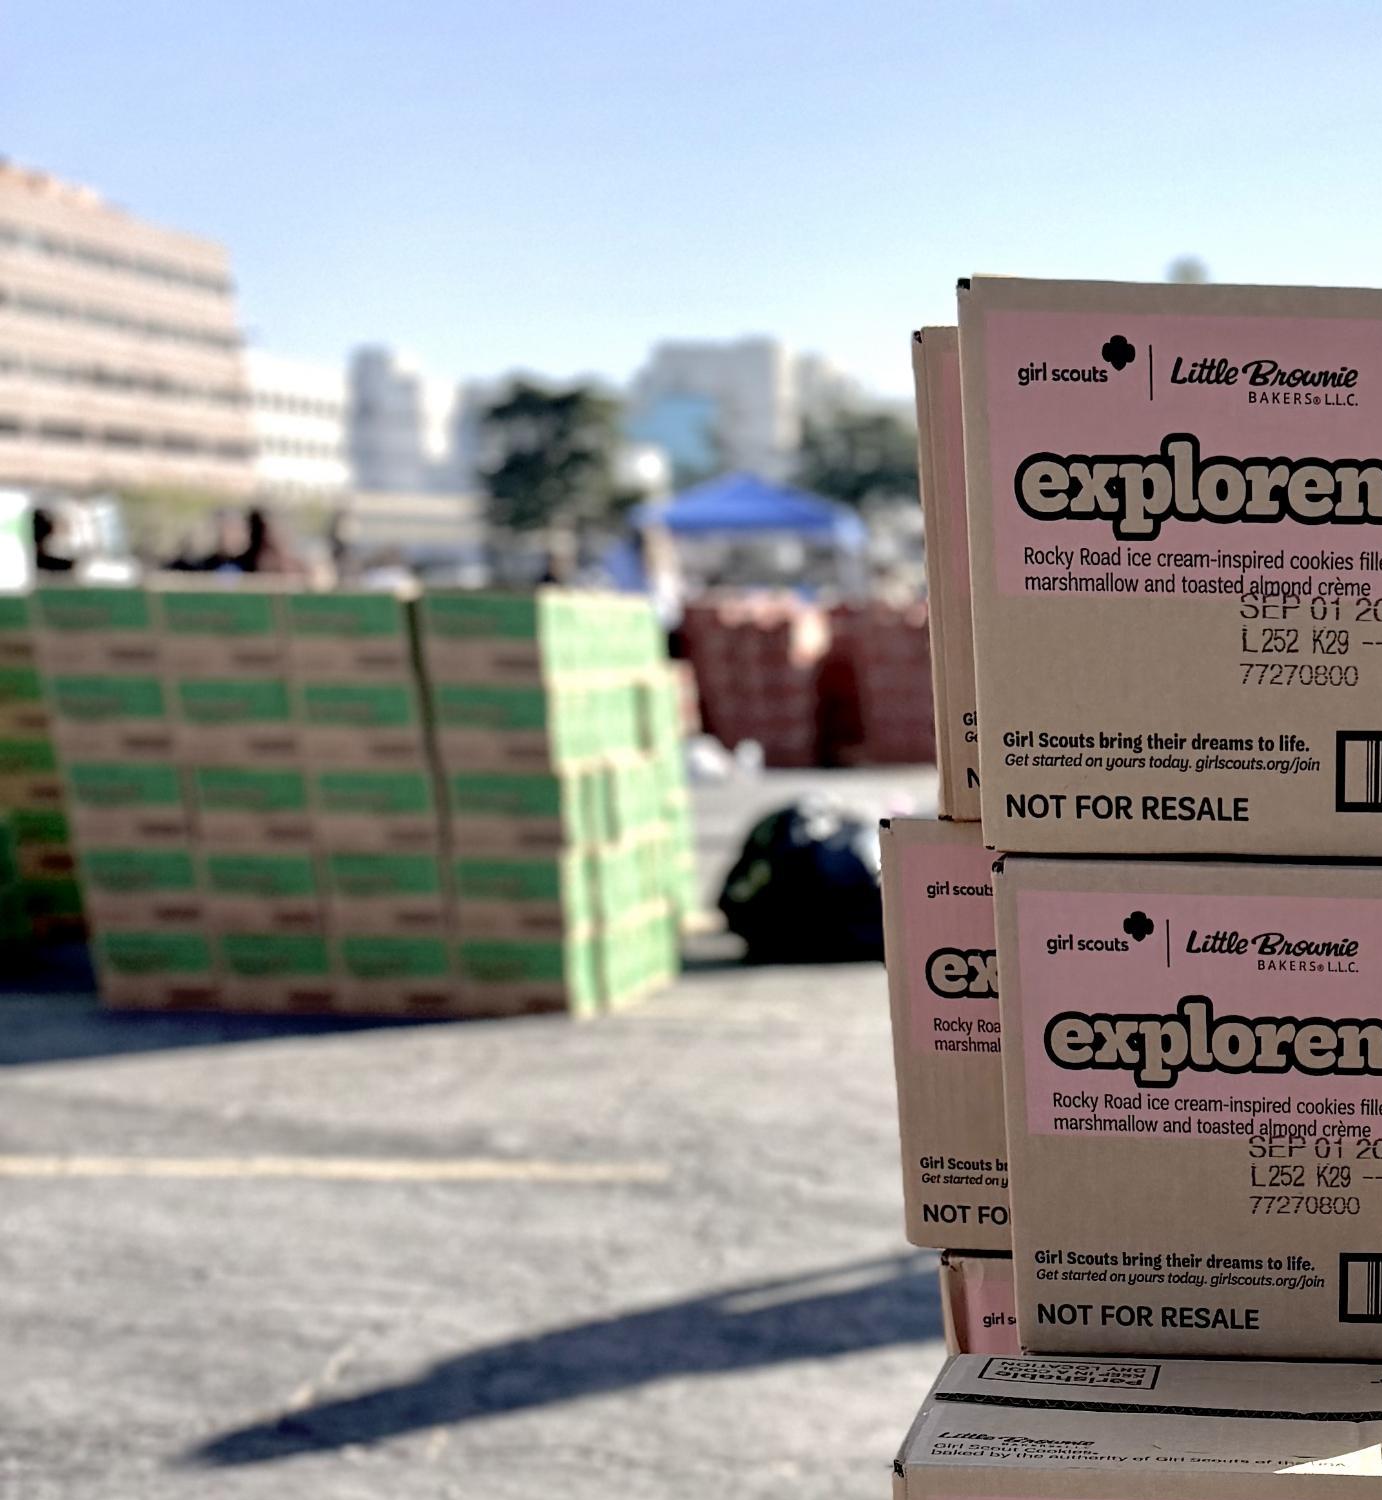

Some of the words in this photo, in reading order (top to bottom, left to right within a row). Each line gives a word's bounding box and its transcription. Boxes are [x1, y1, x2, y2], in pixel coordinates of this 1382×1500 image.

[1018, 362, 1046, 386] girl
[1052, 366, 1108, 382] scouts
[1171, 357, 1238, 385] Little
[1242, 360, 1358, 388] Brownie
[1240, 595, 1301, 623] SEP
[1310, 596, 1340, 620] 01
[1242, 625, 1298, 653] L252
[1313, 630, 1348, 654] K29
[1240, 664, 1358, 686] 77270800
[1004, 731, 1034, 748] Girl
[1039, 733, 1094, 748] Scouts
[1100, 732, 1142, 754] bring
[1147, 733, 1186, 750] their
[1192, 734, 1253, 750] dreams
[1258, 736, 1274, 751] to
[1280, 735, 1309, 752] life.
[1006, 754, 1029, 766] Get
[1032, 753, 1082, 766] started
[1086, 757, 1102, 766] on
[1106, 758, 1146, 771] yours
[1150, 754, 1192, 772] today.
[1196, 755, 1320, 774] girlscouts.org/join
[1007, 794, 1066, 818] NOT
[1076, 795, 1133, 820] FOR
[1142, 796, 1248, 821] RESALE
[927, 881, 949, 898] girl
[1047, 934, 1073, 954] girl
[1078, 938, 1128, 952] scouts
[1186, 930, 1248, 954] Little
[1251, 933, 1358, 956] Brownie
[933, 1017, 972, 1035] Rocky
[978, 1019, 1001, 1033] Roa
[934, 1037, 1001, 1053] marshmal
[1249, 1135, 1306, 1158] SEP
[1315, 1138, 1342, 1158] 01
[920, 1156, 944, 1169] Girl
[948, 1158, 992, 1171] Scouts
[921, 1173, 940, 1184] Get
[943, 1174, 983, 1185] started
[986, 1176, 999, 1186] on
[1252, 1164, 1304, 1186] L252
[1317, 1166, 1351, 1188] K29
[923, 1204, 971, 1223] NOT
[978, 1206, 1011, 1225] FO
[1250, 1196, 1360, 1214] 77270800
[983, 1312, 1004, 1327] girl
[1038, 1304, 1093, 1325] NOT
[1102, 1306, 1153, 1327] FOR
[1162, 1307, 1259, 1329] RESALE
